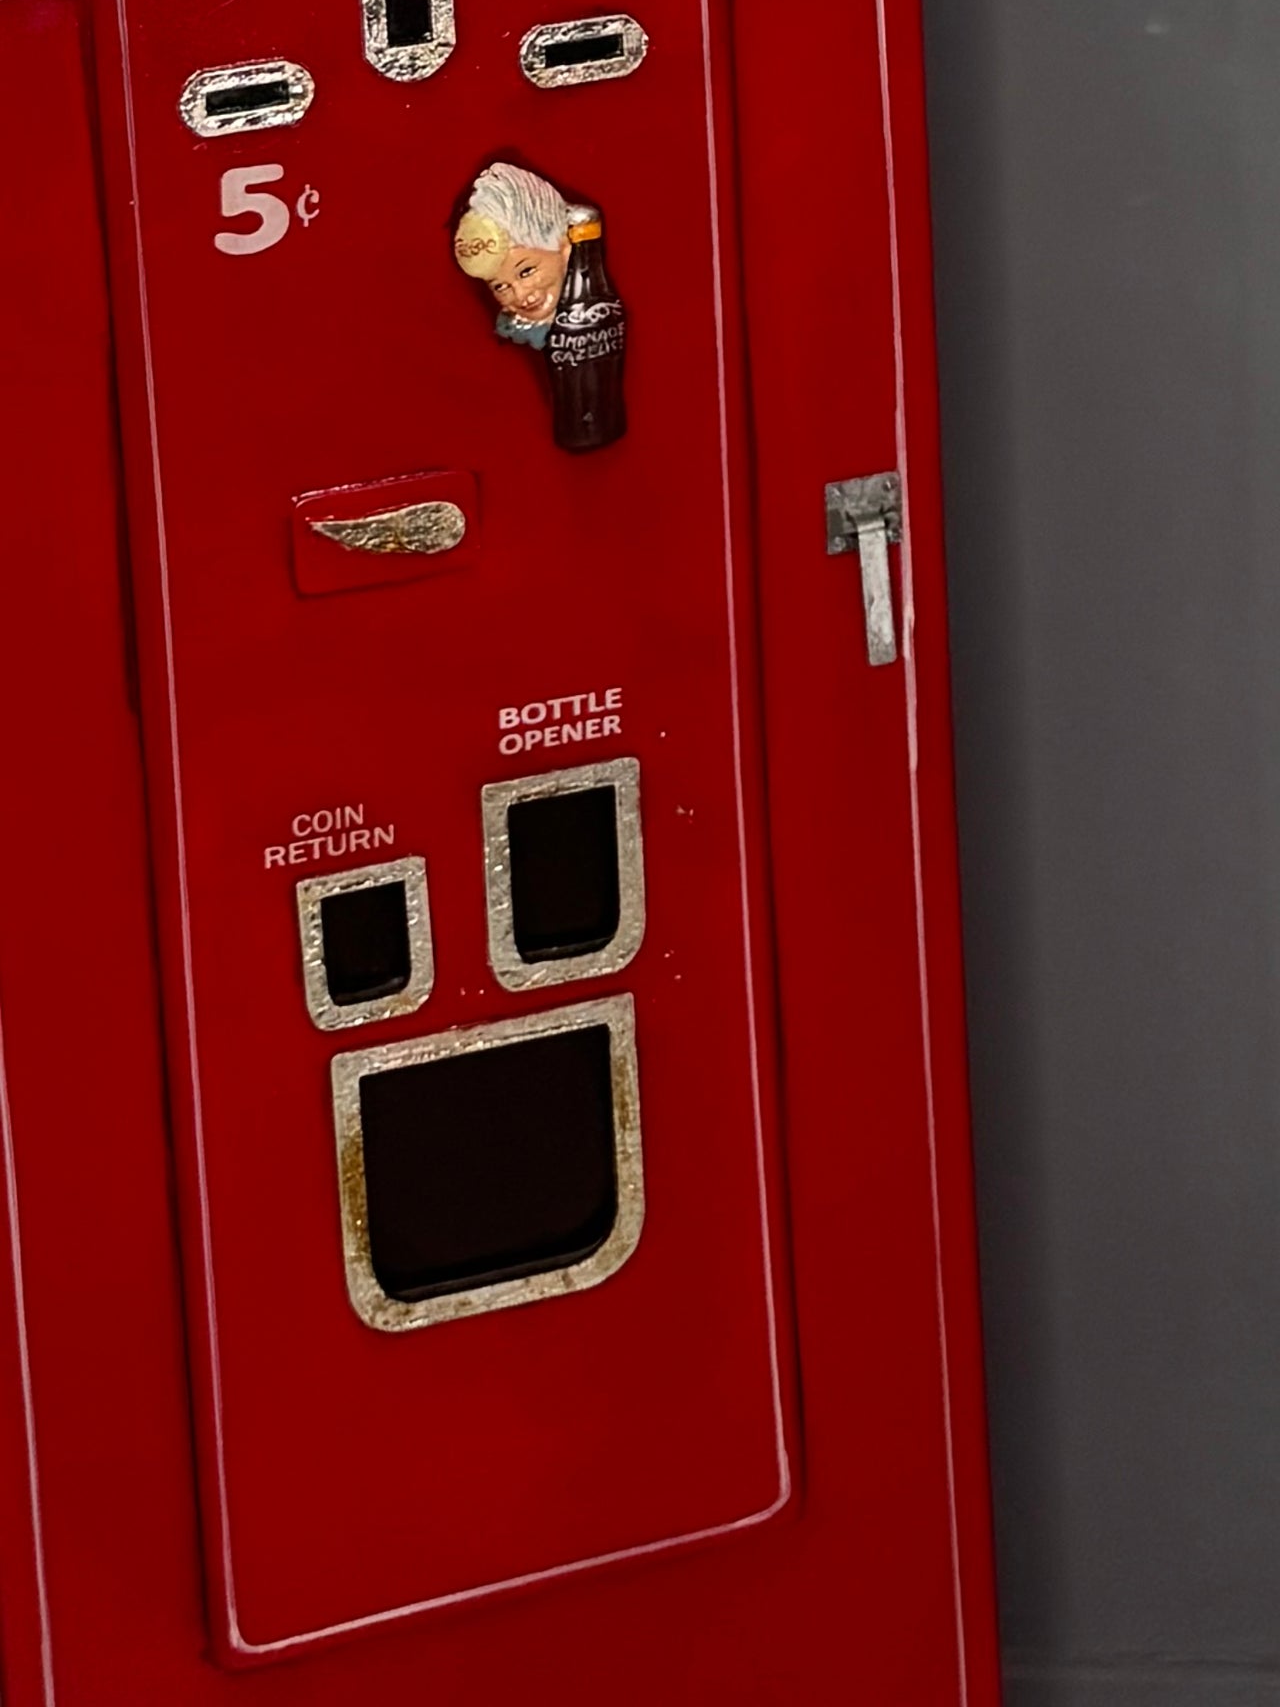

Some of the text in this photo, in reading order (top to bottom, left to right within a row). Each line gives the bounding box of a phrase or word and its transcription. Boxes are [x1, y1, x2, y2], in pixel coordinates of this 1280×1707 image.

[498, 687, 623, 730] BOTTLE
[498, 714, 622, 756] OPENER
[291, 803, 364, 838] COIN
[263, 824, 395, 869] RETURN
